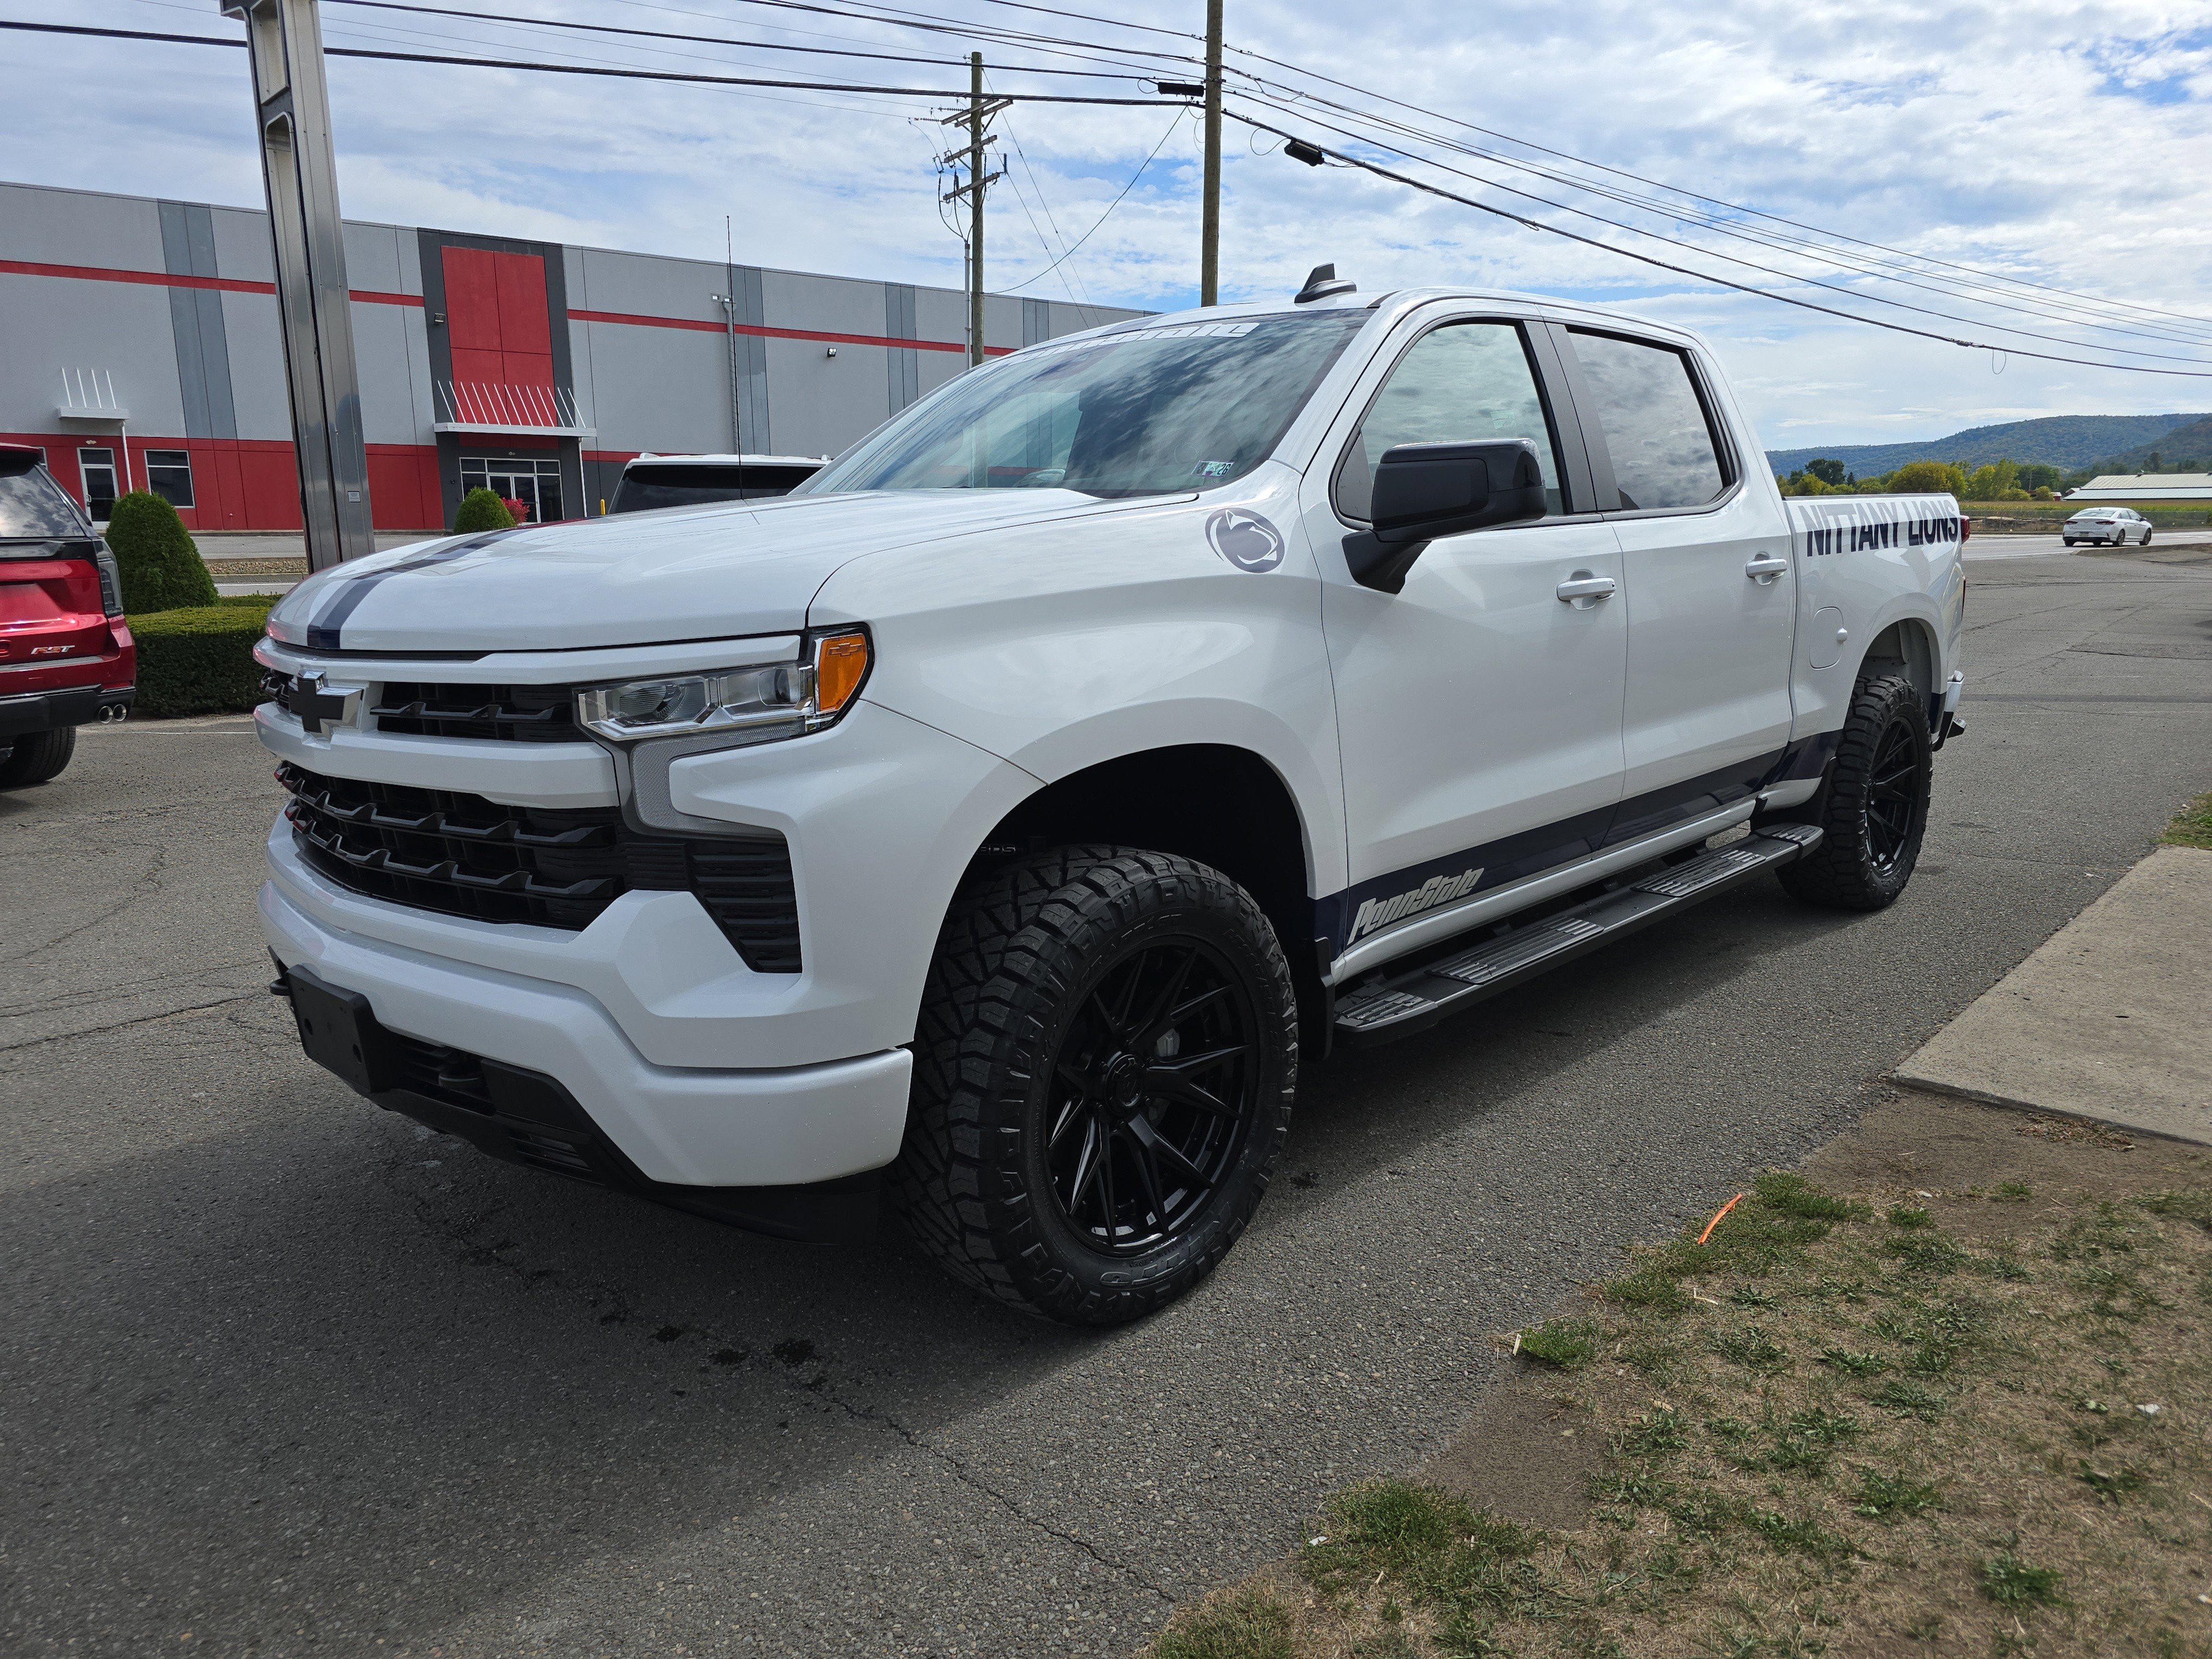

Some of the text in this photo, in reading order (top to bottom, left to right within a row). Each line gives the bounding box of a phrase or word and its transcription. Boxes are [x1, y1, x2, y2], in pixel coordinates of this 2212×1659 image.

[1217, 463, 1231, 475] 26
[1798, 499, 1958, 557] NITTANY LIONS
[31, 645, 75, 655] RST
